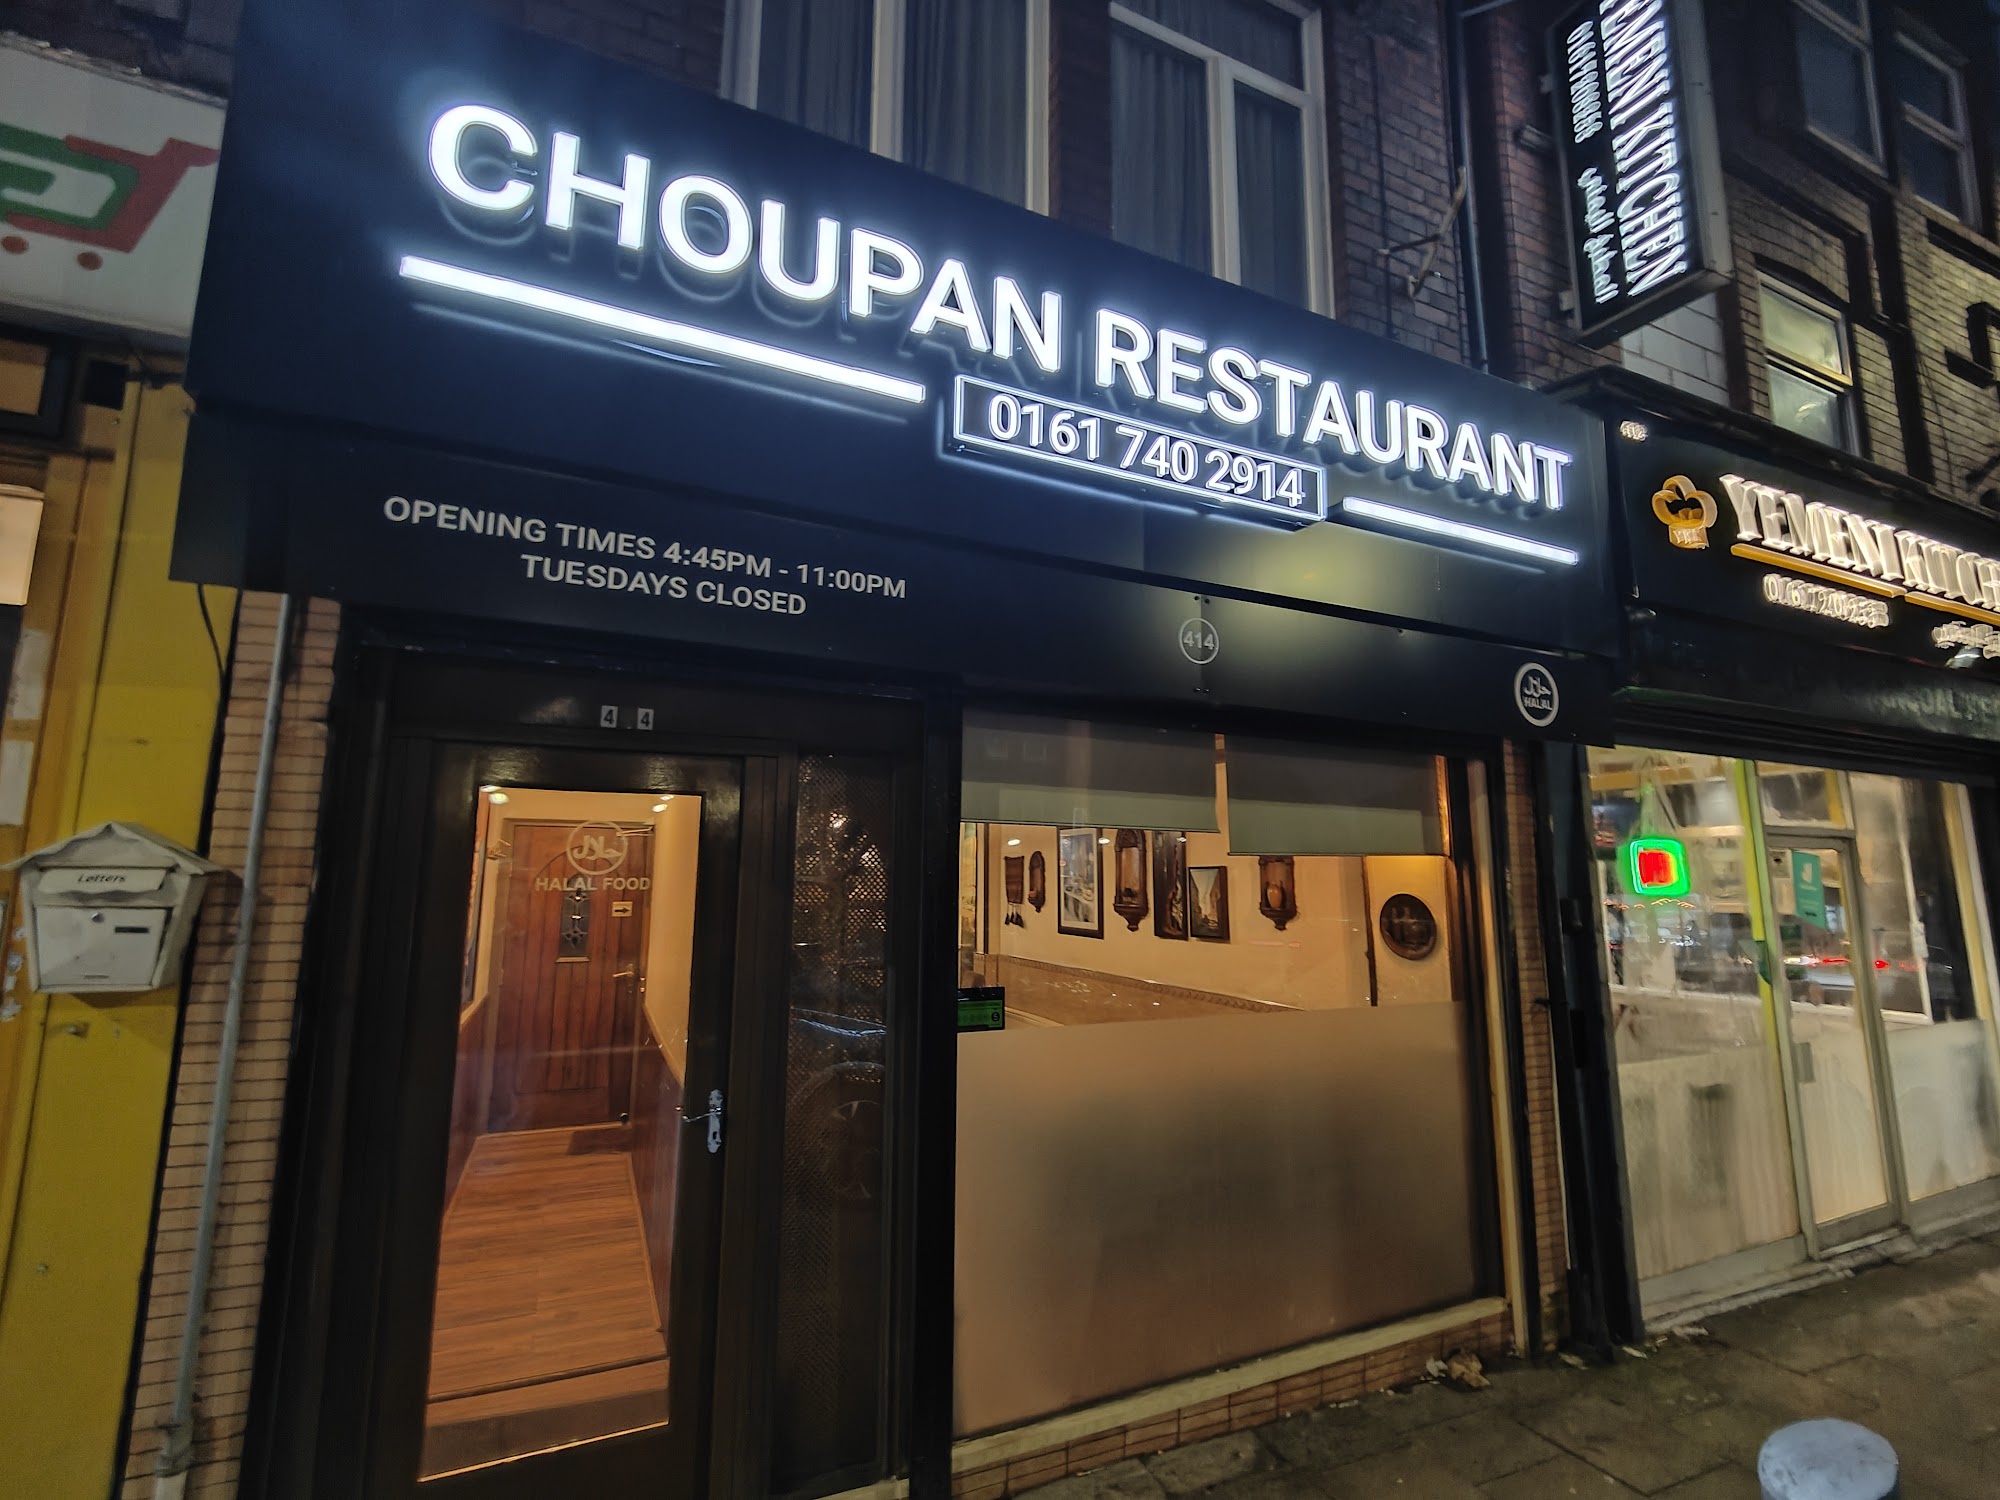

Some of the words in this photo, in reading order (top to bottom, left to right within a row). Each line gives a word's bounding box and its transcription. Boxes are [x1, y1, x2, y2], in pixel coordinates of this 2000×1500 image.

[1612, 101, 1687, 297] KITCHEN
[428, 104, 1062, 373] CHOUPAN
[1095, 307, 1573, 511] RESTAURANT
[988, 393, 1101, 461] 0161
[1113, 423, 1198, 483] 740
[1203, 450, 1306, 507] 2914
[383, 496, 547, 543] OPENING
[554, 523, 656, 560] TIMES
[663, 542, 771, 579] 4:45PM
[798, 564, 906, 599] 11:00PM
[1719, 474, 1905, 582] YEMENI
[521, 554, 688, 599] TUESDAYS
[696, 582, 807, 615] CLOSED
[1182, 630, 1215, 650] 414
[1522, 696, 1554, 711] HALAL
[77, 872, 128, 884] Letters
[535, 876, 599, 892] HALAL
[602, 876, 651, 891] FOOD
